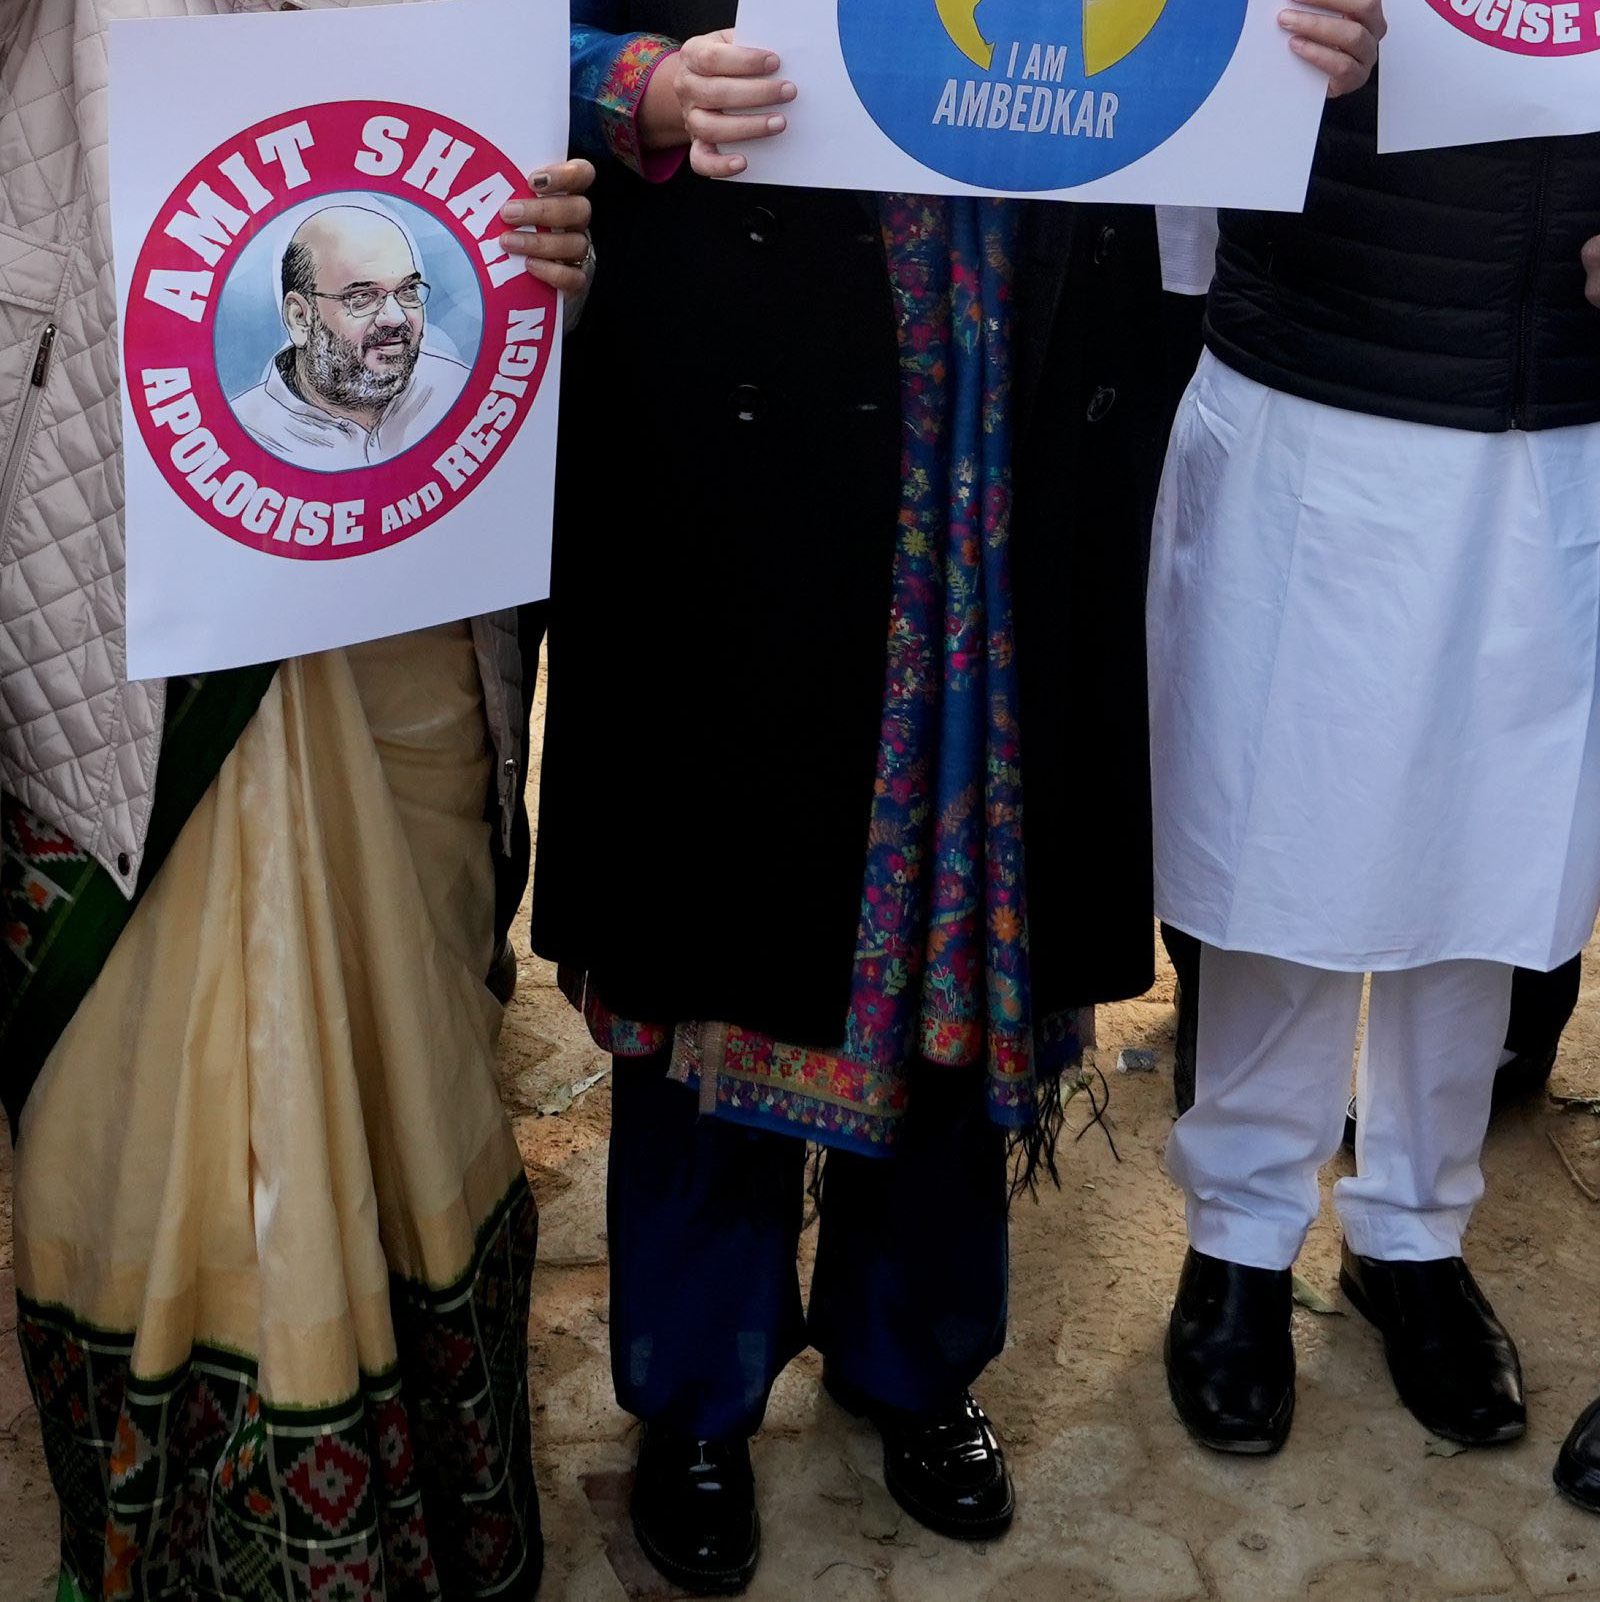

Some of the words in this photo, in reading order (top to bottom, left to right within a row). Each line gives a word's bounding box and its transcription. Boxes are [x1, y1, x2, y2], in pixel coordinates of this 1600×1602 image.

[931, 78, 1119, 139] AMBEDKAR
[1006, 41, 1020, 79] I
[1021, 43, 1068, 83] AM
[143, 119, 317, 324] AMIT
[140, 366, 366, 547] APOLOGISE
[380, 481, 445, 535] AND
[432, 306, 546, 492] RESIGN
